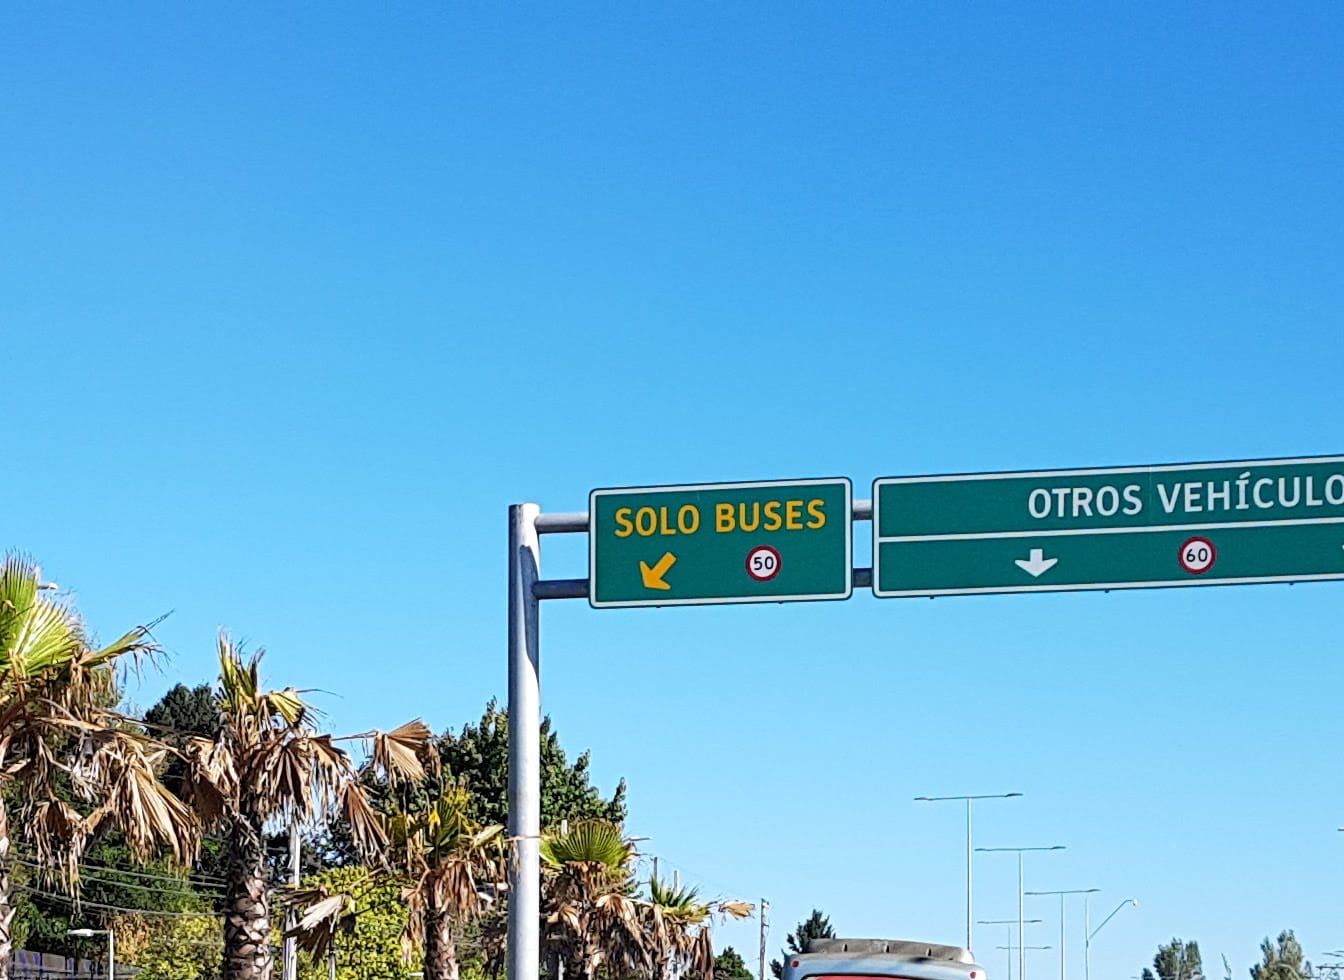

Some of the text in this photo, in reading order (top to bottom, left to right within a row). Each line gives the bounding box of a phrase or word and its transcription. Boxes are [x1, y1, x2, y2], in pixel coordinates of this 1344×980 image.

[1027, 484, 1143, 519] OTROS
[614, 499, 827, 538] SOLO BUSES
[752, 556, 775, 571] 50
[1185, 547, 1209, 563] 60
